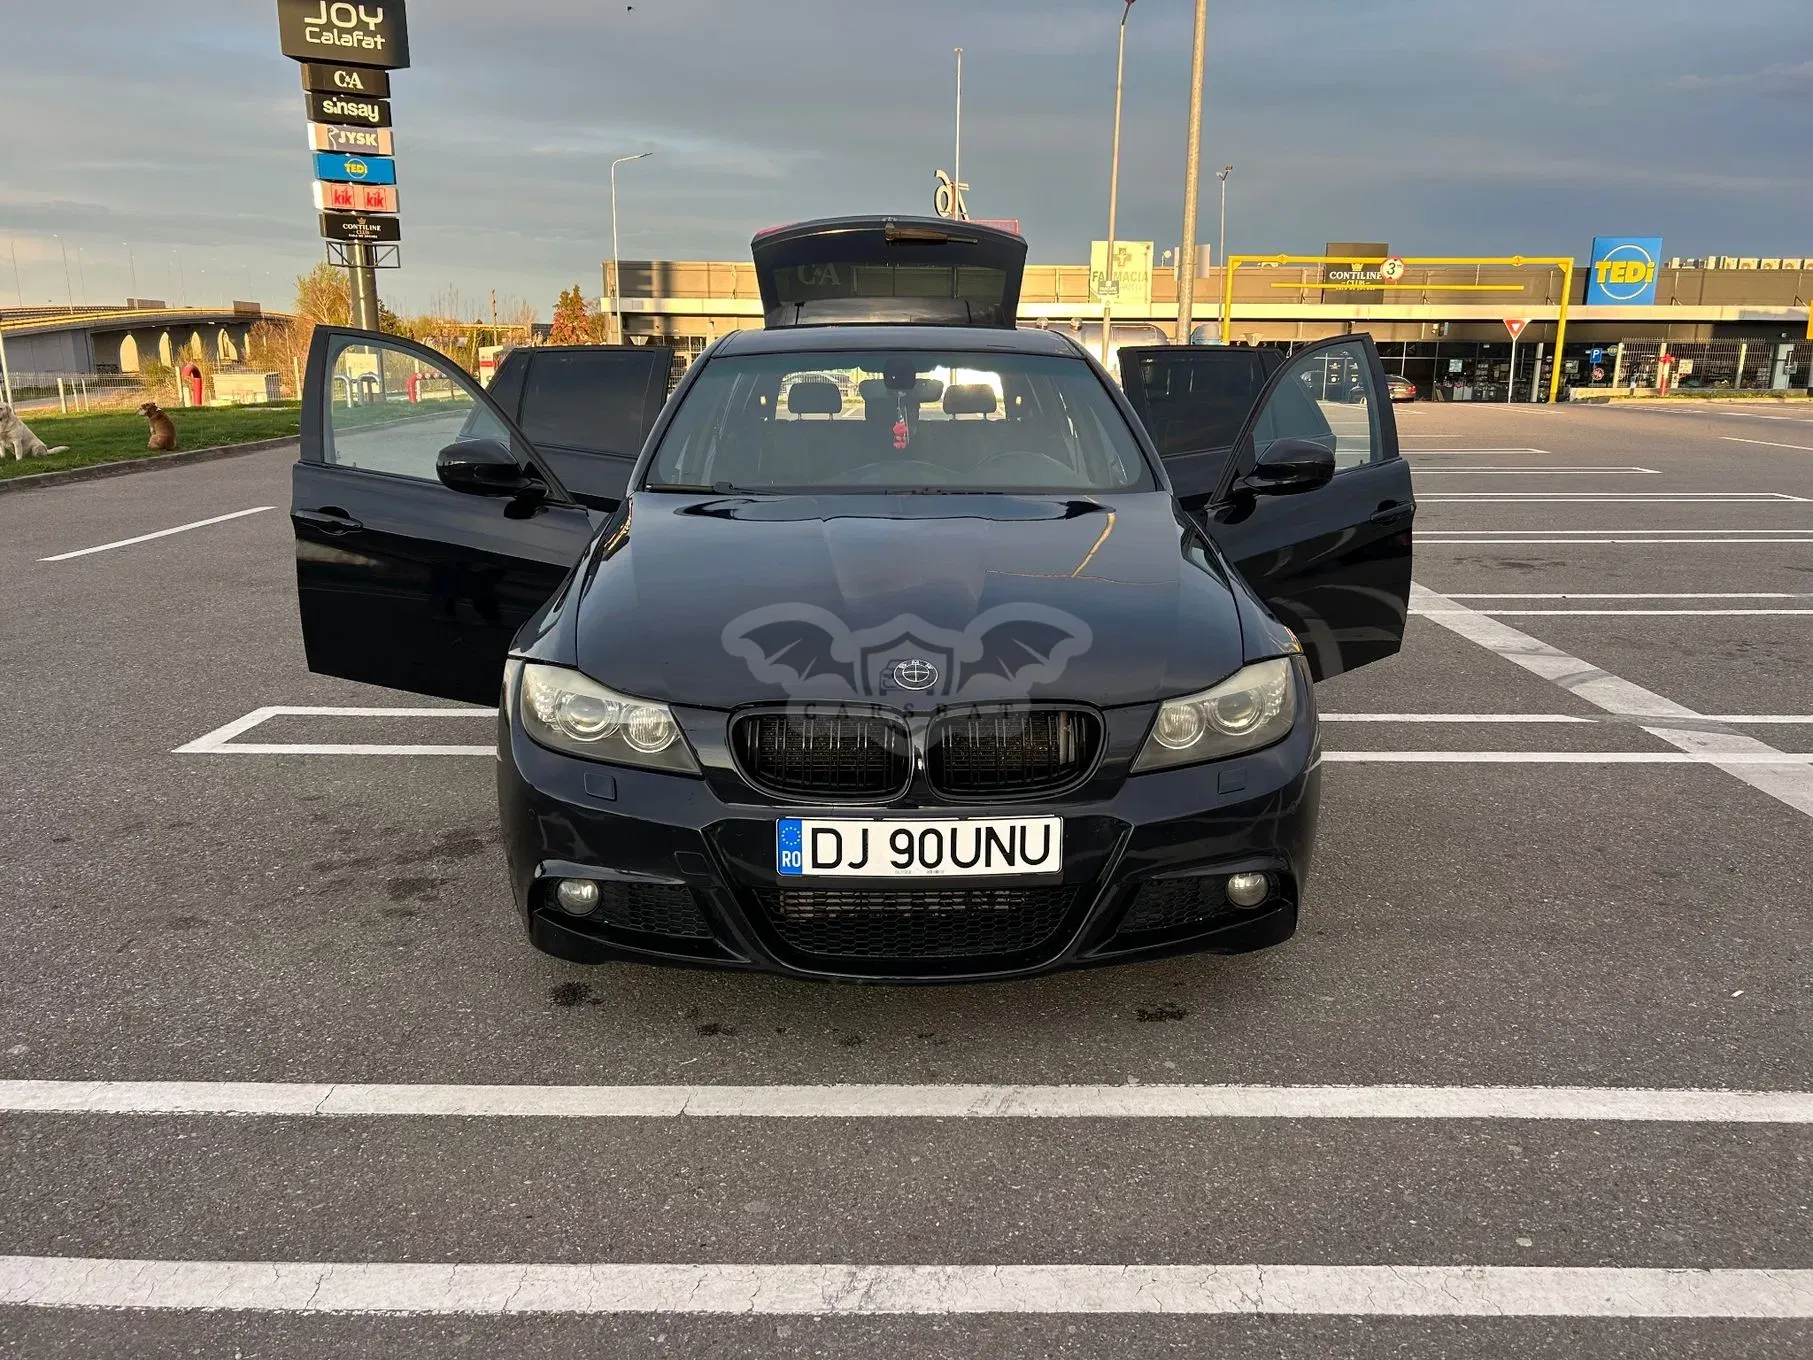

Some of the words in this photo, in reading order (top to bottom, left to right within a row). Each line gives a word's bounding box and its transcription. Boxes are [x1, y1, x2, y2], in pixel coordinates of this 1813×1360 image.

[304, 0, 383, 31] JOY
[305, 26, 386, 50] Calafat
[334, 70, 364, 90] C&A
[323, 97, 380, 122] sinsay
[338, 130, 378, 147] JYSK
[342, 223, 382, 232] CONTILINE
[1092, 271, 1148, 282] FAMACIA
[1329, 271, 1384, 280] CONTILINE
[1594, 261, 1656, 284] TEDi
[812, 827, 869, 869] DJ
[782, 851, 801, 867] RO
